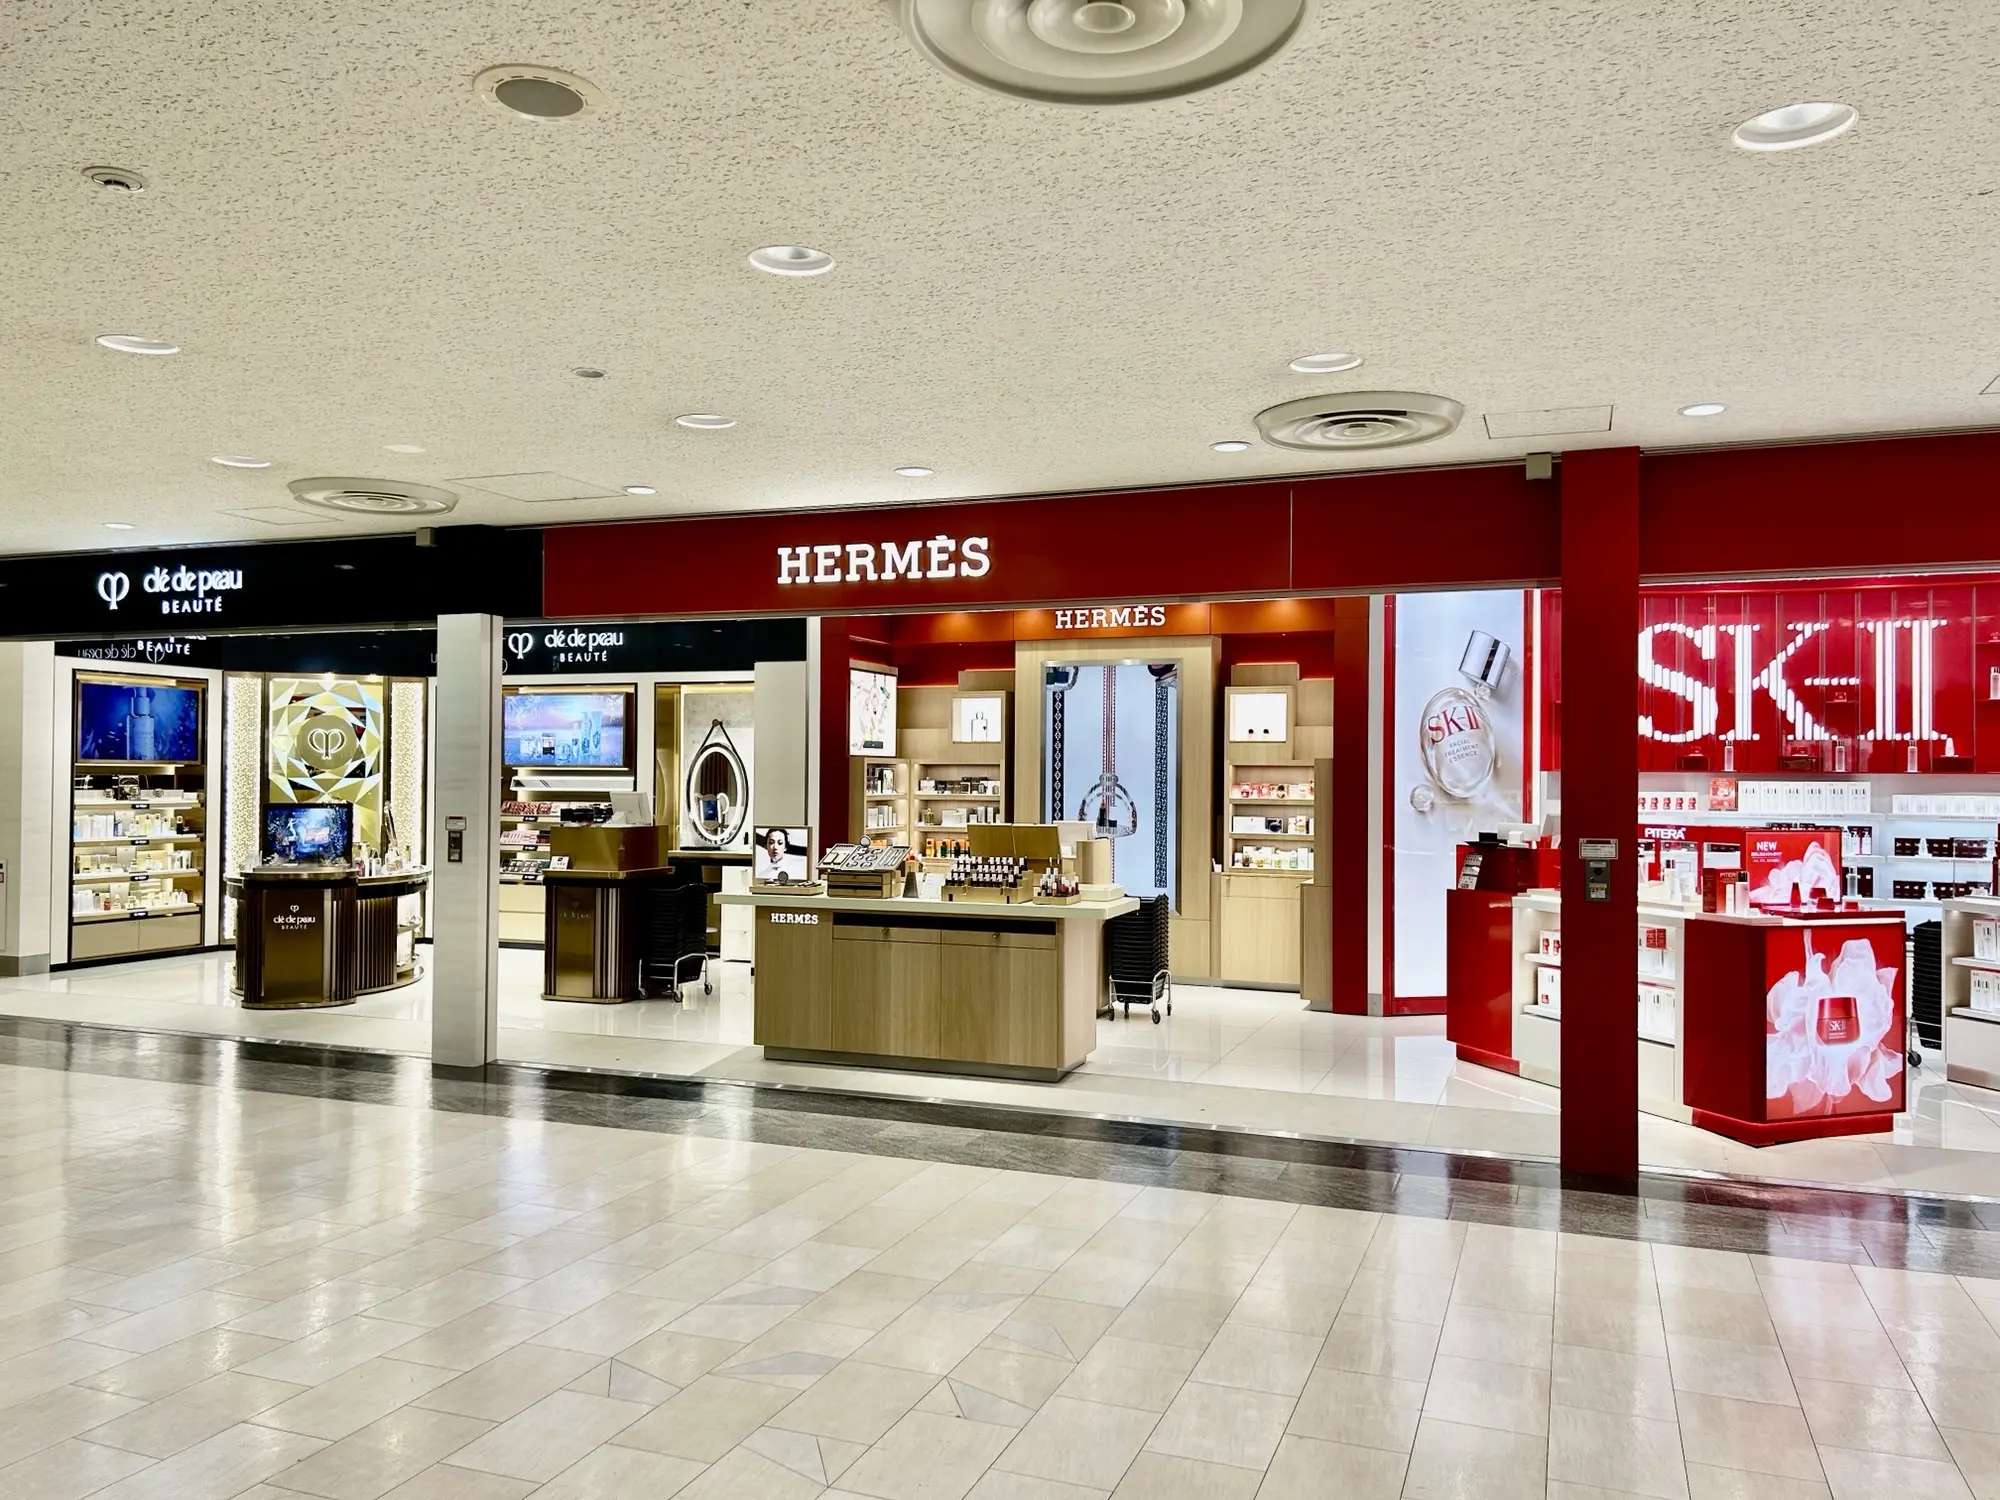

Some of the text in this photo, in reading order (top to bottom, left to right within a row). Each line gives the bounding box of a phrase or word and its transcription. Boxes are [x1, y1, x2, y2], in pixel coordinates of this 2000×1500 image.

[777, 535, 990, 584] HERMÈS
[171, 564, 197, 592] de
[198, 570, 243, 598] peau
[161, 596, 223, 614] BEAUTÉ
[1055, 605, 1166, 629] HERMÈS
[567, 628, 587, 647] de
[588, 632, 623, 651] peau
[559, 650, 608, 662] BEAUTÉ
[1638, 619, 1948, 743] SK-II
[1428, 704, 1481, 745] SK-II
[1756, 841, 1778, 852] NEW
